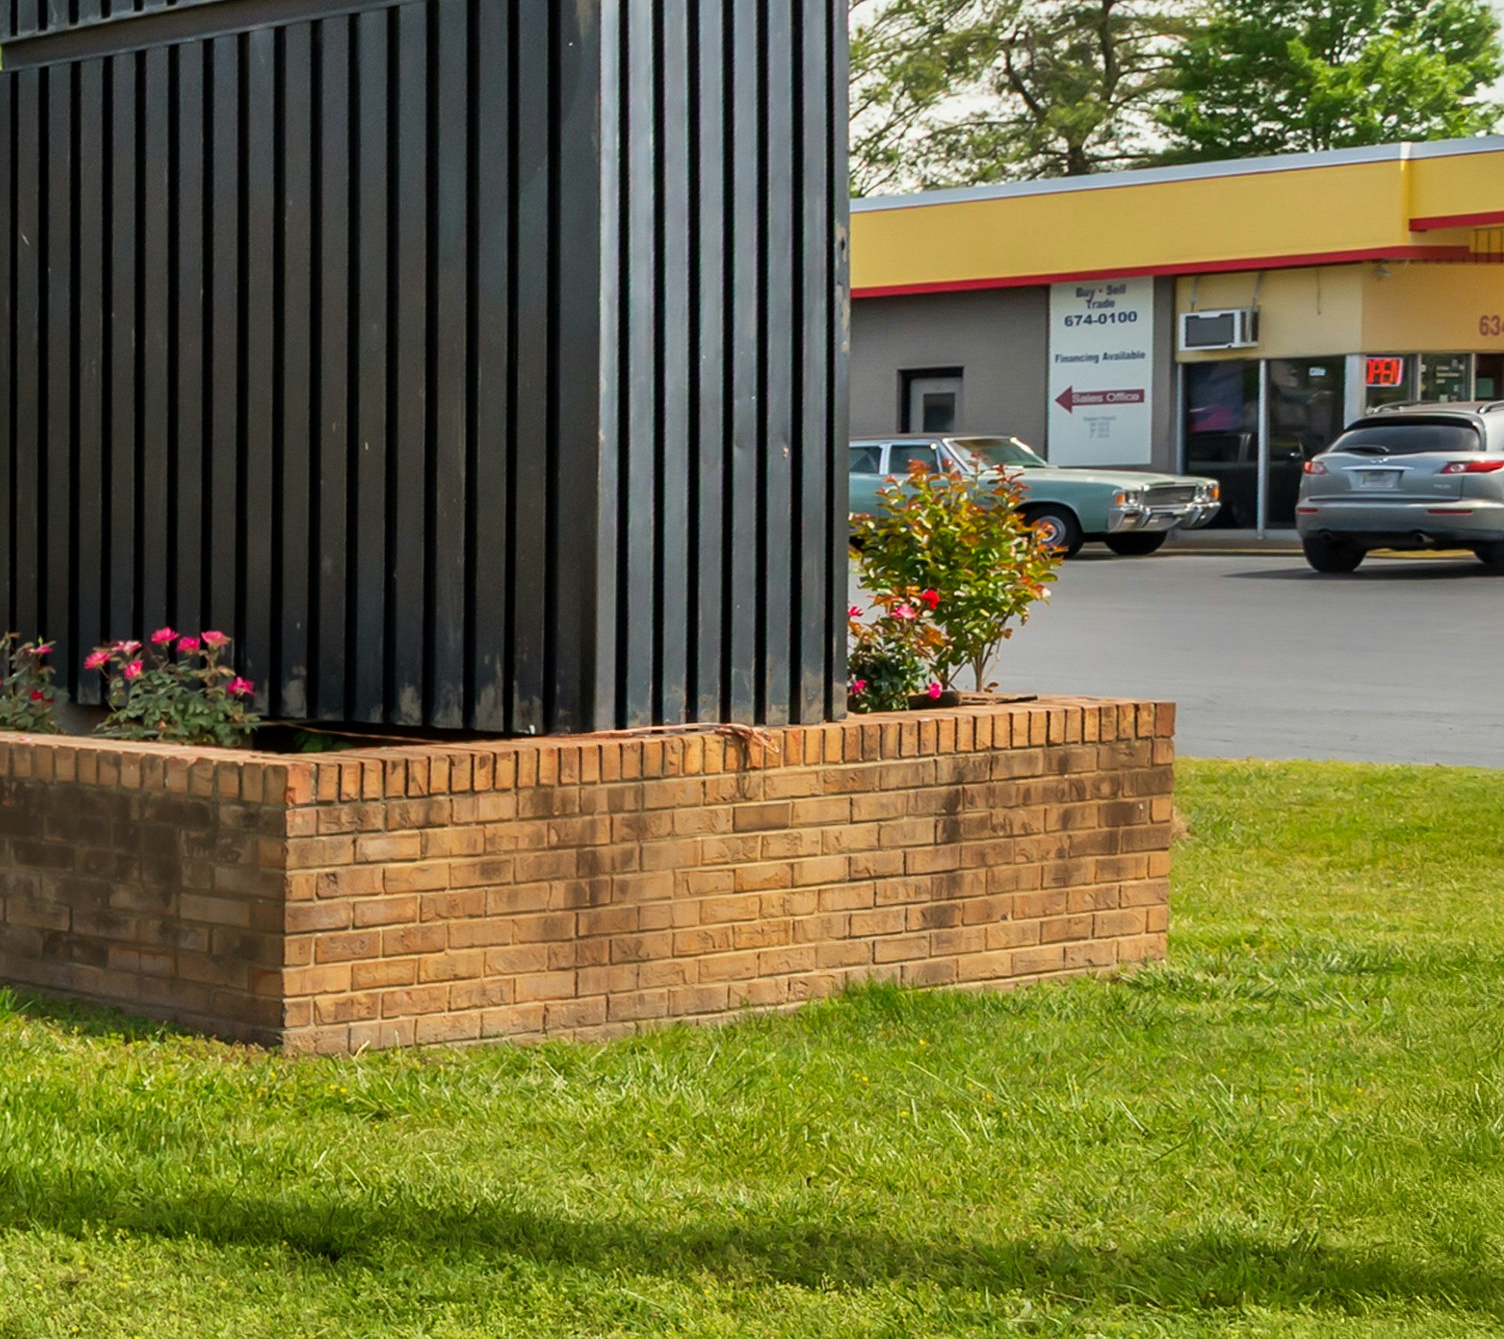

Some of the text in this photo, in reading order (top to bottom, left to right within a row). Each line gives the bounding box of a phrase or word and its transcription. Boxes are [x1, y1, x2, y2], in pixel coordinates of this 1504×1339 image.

[1076, 284, 1126, 301] Buy Sell
[1086, 299, 1115, 309] Trade
[1064, 311, 1137, 327] 674-0100
[1479, 315, 1504, 337] 63
[1055, 350, 1146, 363] Financing Available
[1072, 392, 1140, 403] Sales Office
